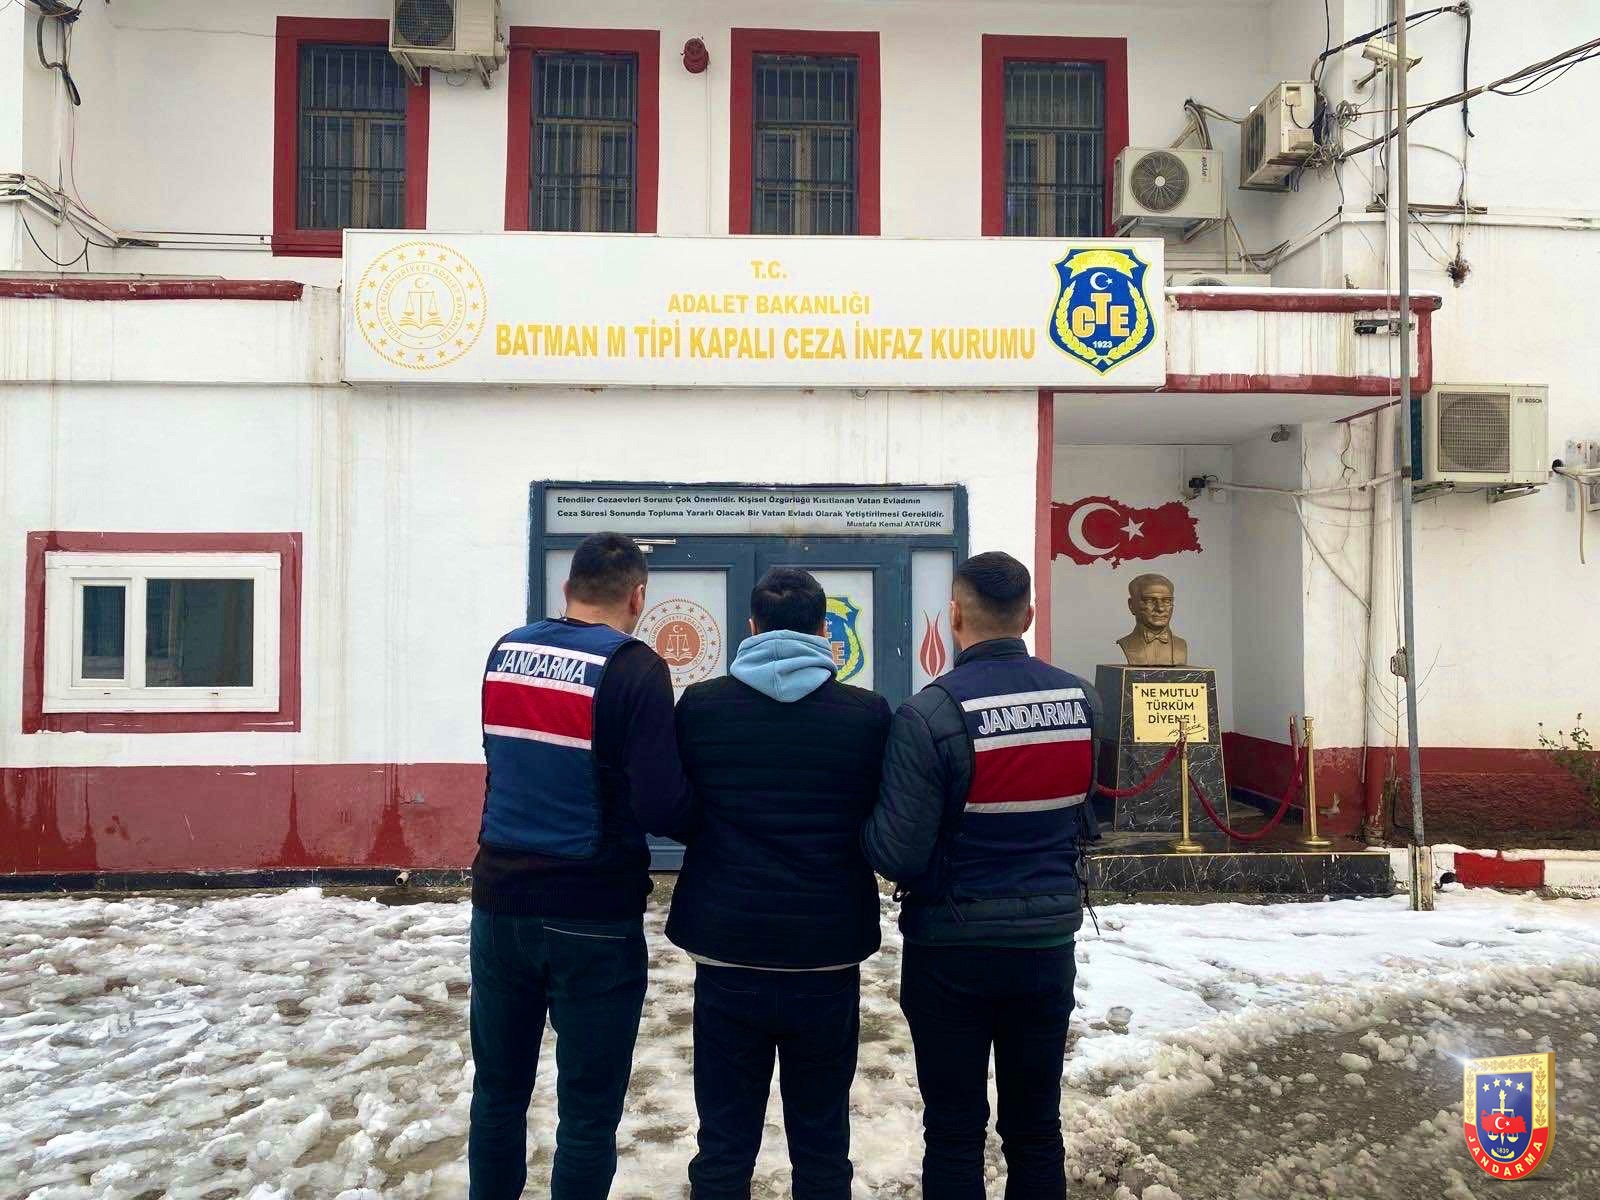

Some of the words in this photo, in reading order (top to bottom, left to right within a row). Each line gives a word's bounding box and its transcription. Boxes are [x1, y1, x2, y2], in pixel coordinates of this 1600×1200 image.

[752, 261, 788, 278] T.C.
[668, 294, 748, 314] ADALET
[756, 291, 870, 315] BAKANLIĞI
[496, 324, 598, 357] BATMAN
[607, 325, 626, 357] M
[634, 319, 682, 358] TİPİ
[690, 327, 775, 360] KAPALI
[784, 327, 847, 361] CEZA
[855, 321, 923, 360] İNFAZ
[931, 327, 1035, 361] KURUMU
[675, 495, 692, 505] Çok
[738, 496, 767, 505] Kişisel
[768, 495, 811, 505] Özgürlüğü
[813, 496, 855, 504] Kısıtlanan
[580, 509, 607, 517] Süresi
[609, 509, 646, 517] Sonunda
[648, 509, 684, 518] Topluma
[686, 509, 714, 517] Yararlı
[716, 509, 746, 517] Olacak
[747, 509, 760, 517] Bir
[761, 509, 786, 517] Vatan
[788, 509, 813, 517] Evladı
[845, 510, 900, 519] Yetiştirilmesi
[901, 510, 945, 518] Gereklidir.
[904, 520, 942, 528] ATATÜRK
[497, 650, 587, 684] JANDARMA
[1141, 688, 1156, 697] NE
[1160, 688, 1199, 697] MUTLU
[1146, 699, 1194, 710] TÜRKÜM
[978, 701, 1087, 735] JANDARMA
